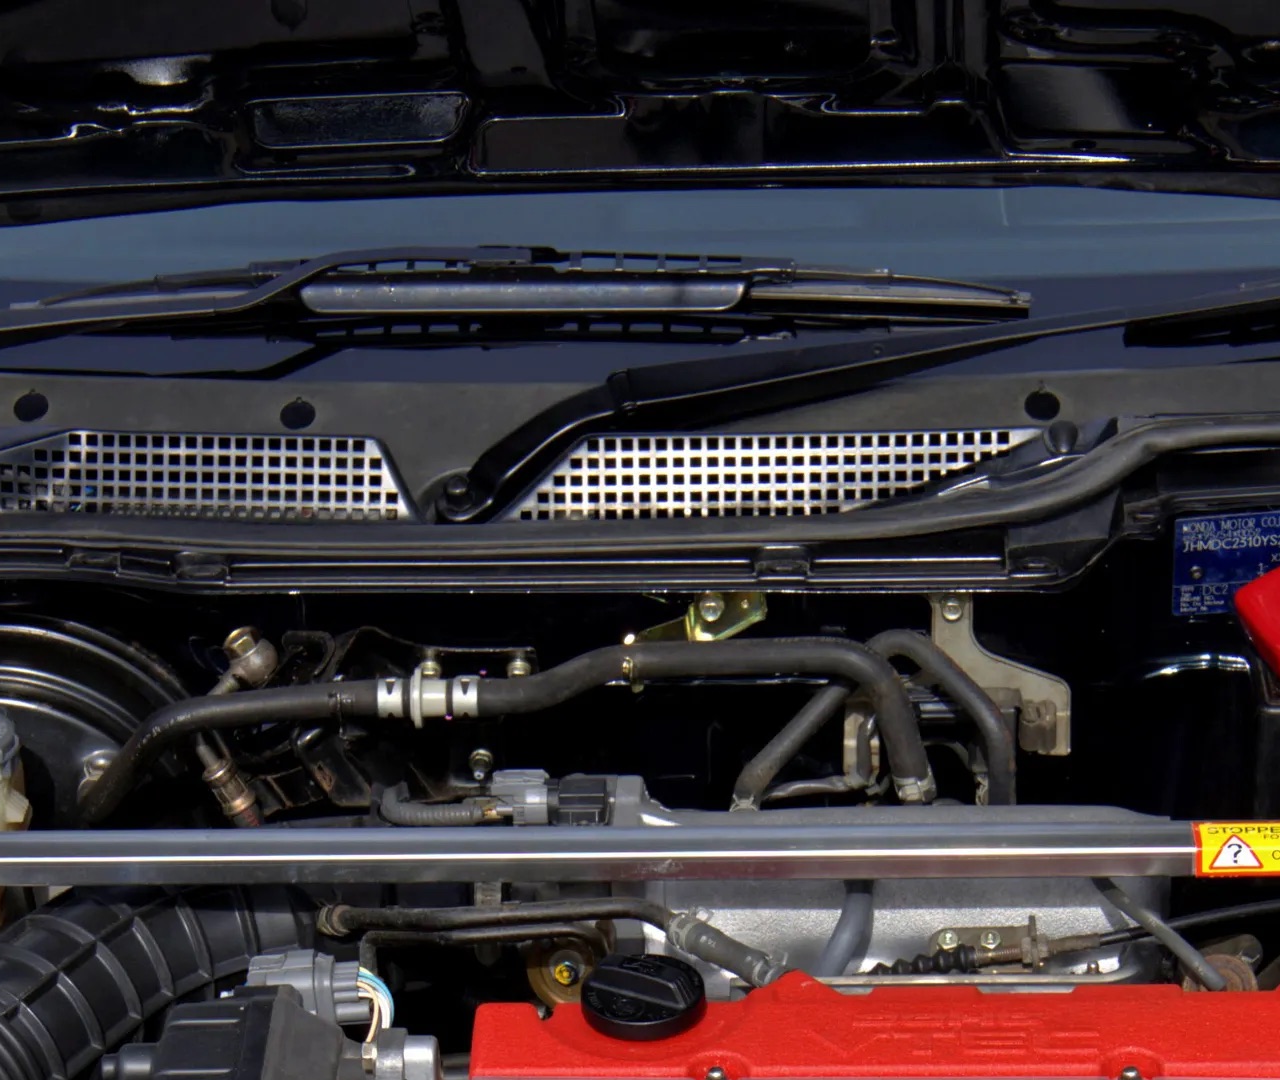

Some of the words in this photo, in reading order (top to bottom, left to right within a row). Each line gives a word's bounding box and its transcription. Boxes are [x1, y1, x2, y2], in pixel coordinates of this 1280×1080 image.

[1221, 517, 1256, 531] MOTOR
[1202, 584, 1228, 596] DC2
[808, 1031, 1101, 1057] VTEC
